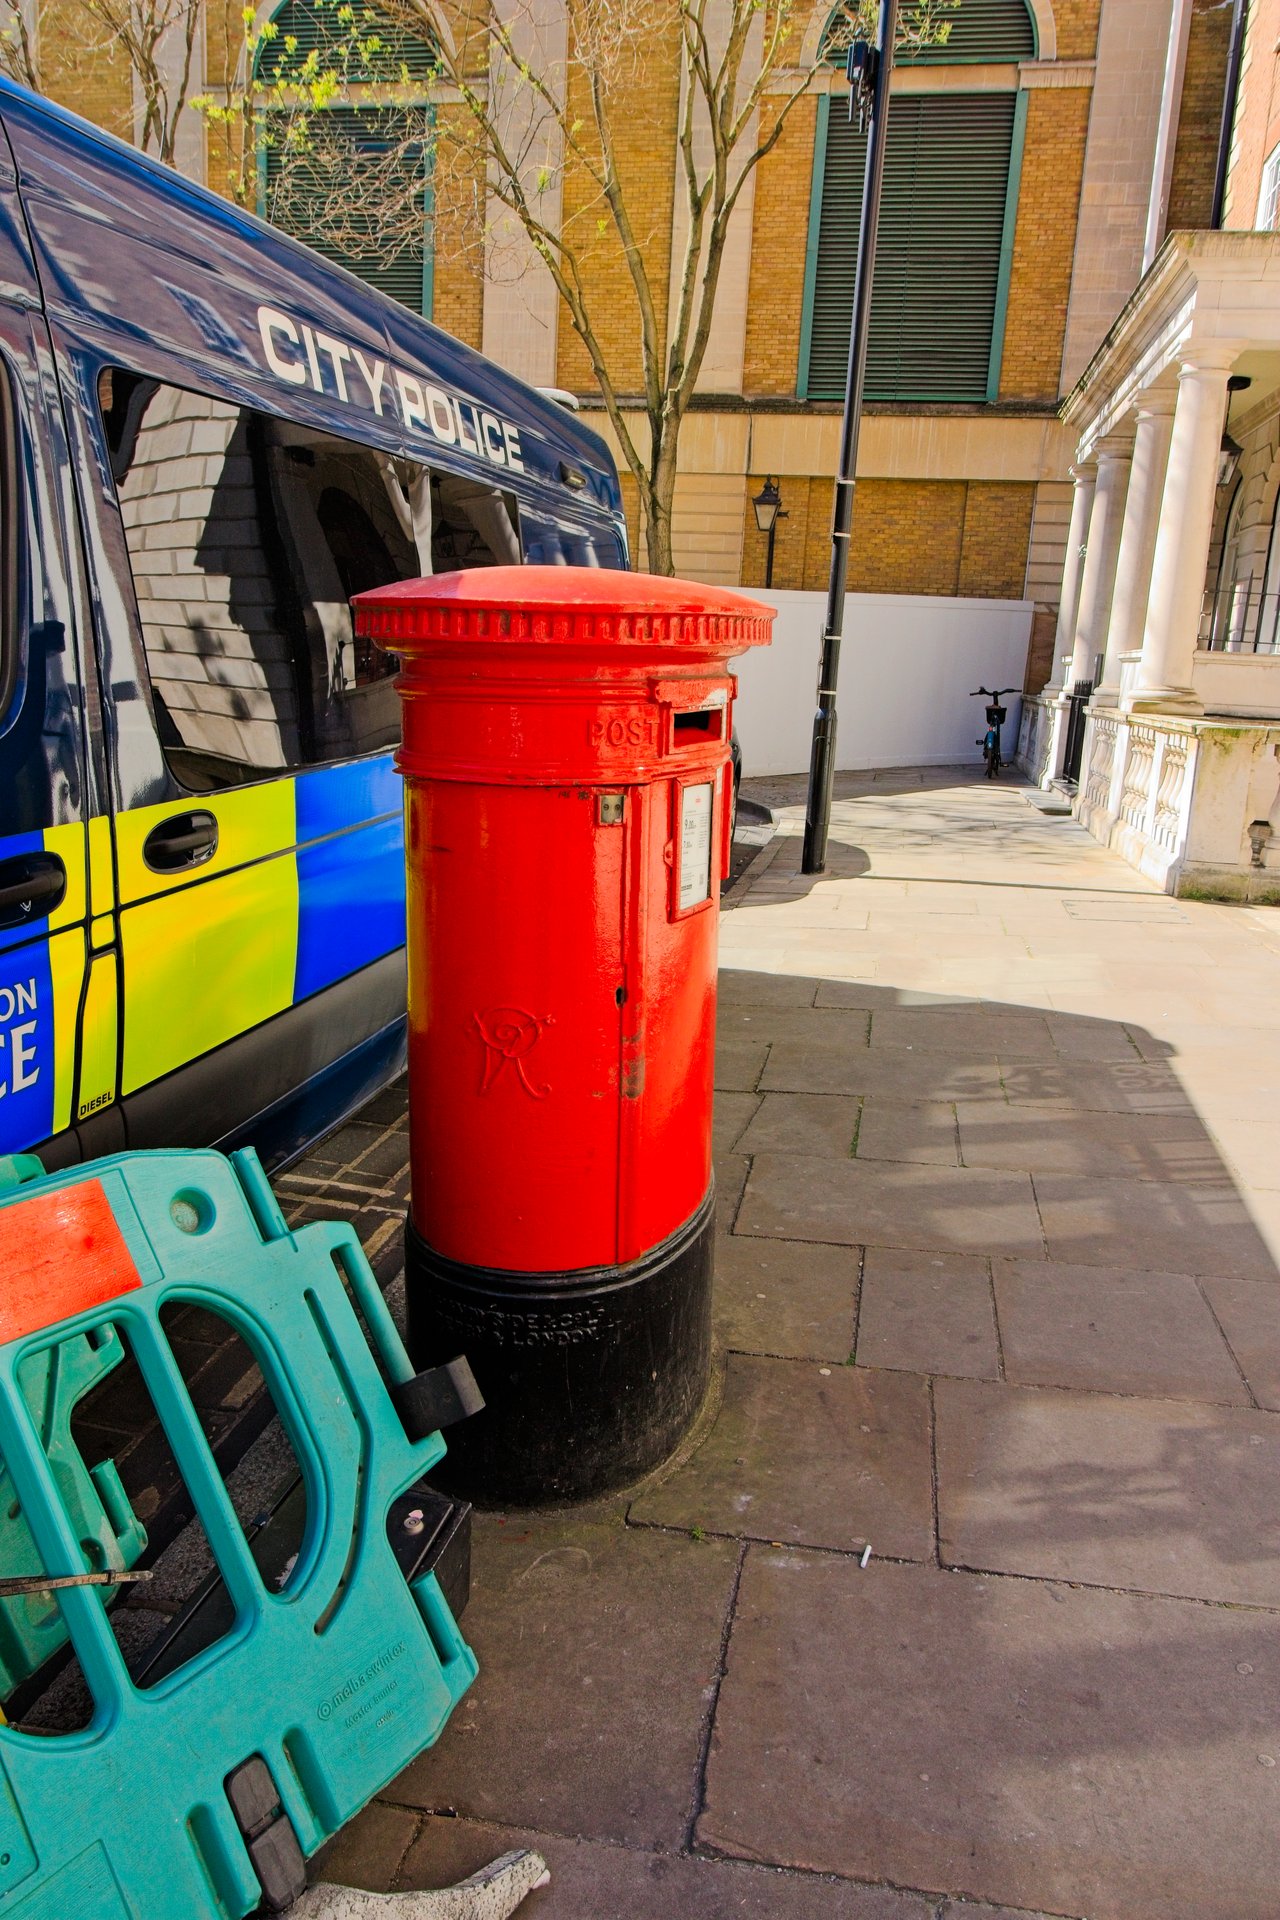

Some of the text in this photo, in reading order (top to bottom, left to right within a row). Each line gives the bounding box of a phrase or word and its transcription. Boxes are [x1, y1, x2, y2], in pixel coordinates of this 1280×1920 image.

[257, 306, 525, 473] CITY POLICE
[585, 717, 660, 748] POST
[79, 1091, 113, 1117] DIESEL
[332, 1641, 407, 1708] melba swintex
